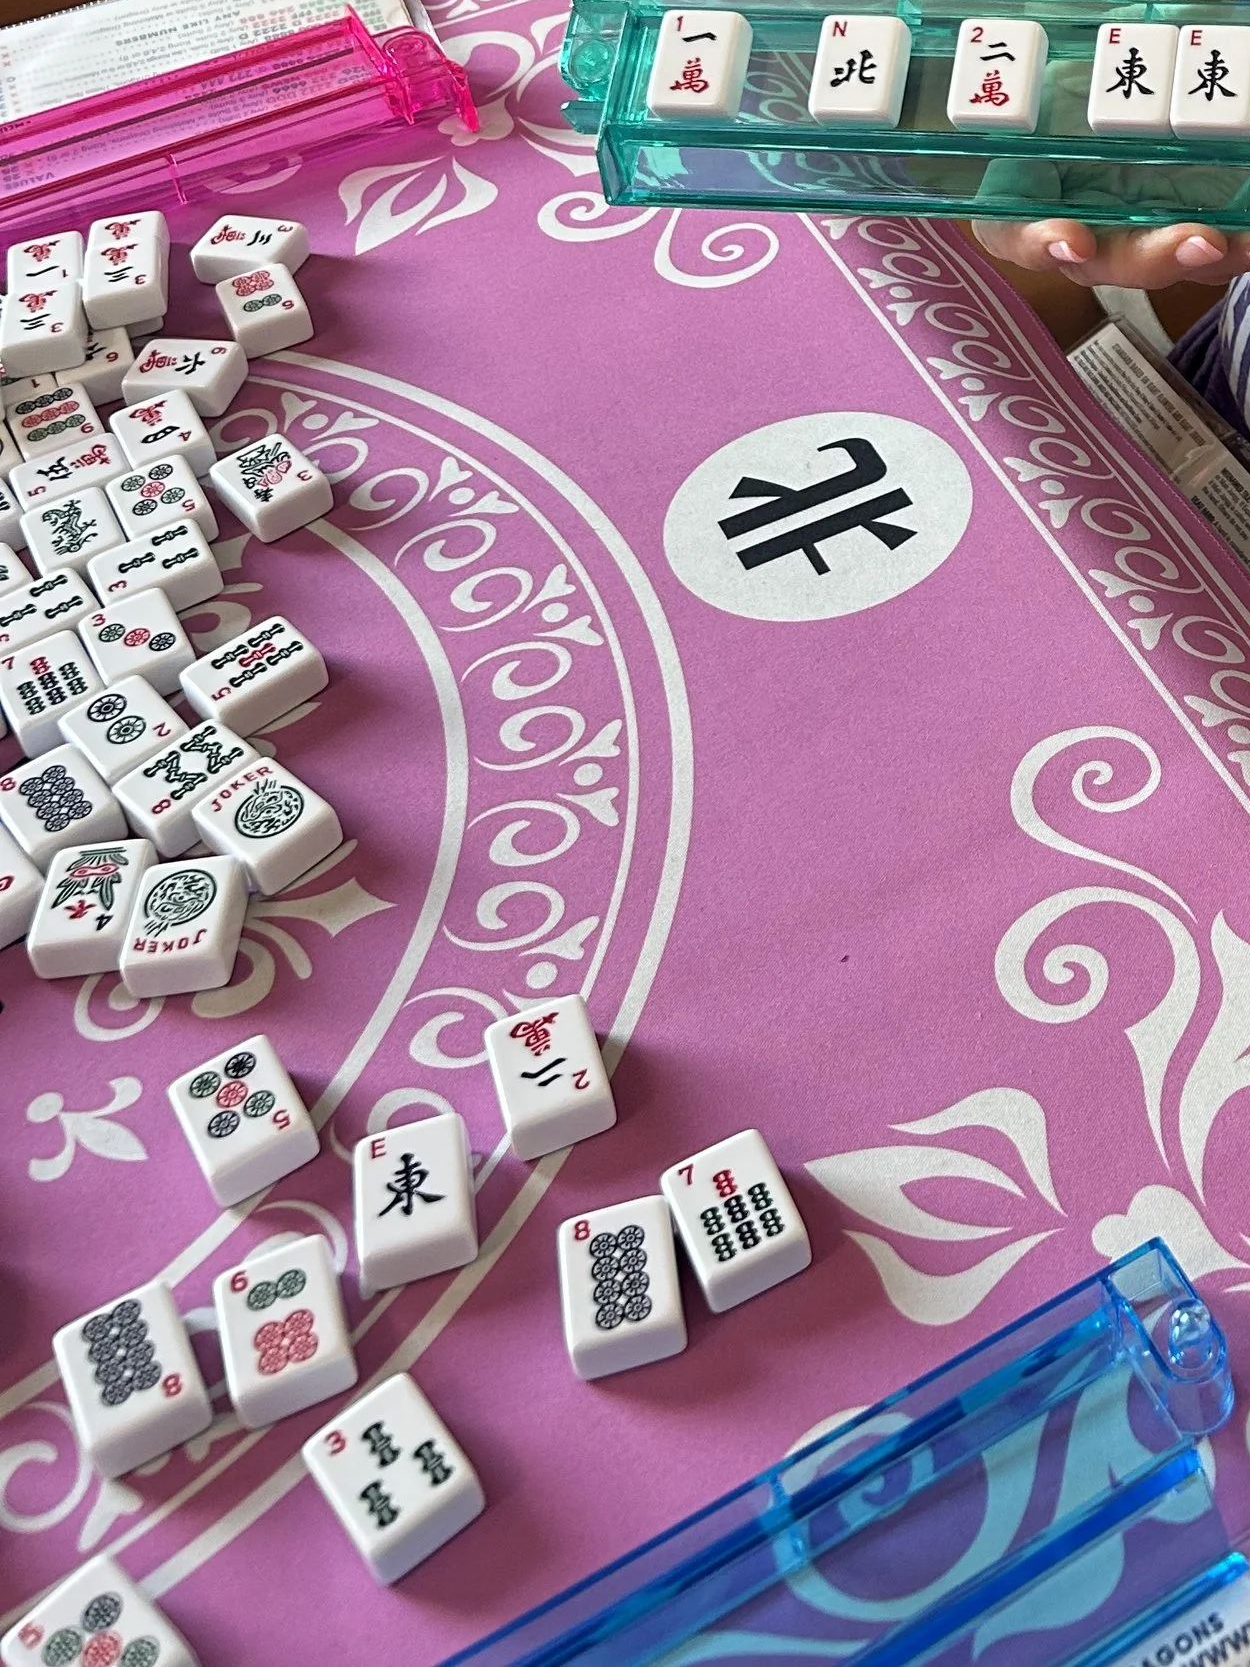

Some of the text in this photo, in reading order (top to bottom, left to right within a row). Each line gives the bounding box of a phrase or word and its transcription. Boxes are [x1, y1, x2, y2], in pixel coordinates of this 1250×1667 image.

[676, 16, 686, 32] 1
[833, 21, 849, 37] N
[970, 27, 984, 43] 2
[1109, 28, 1121, 44] E
[1190, 30, 1203, 46] E
[830, 49, 877, 88] 北
[1105, 47, 1155, 100] 東
[1187, 49, 1238, 102] 東
[717, 437, 918, 576] 北
[91, 613, 107, 628] 3
[1, 656, 16, 671] 7
[152, 722, 172, 738] 2
[211, 766, 274, 813] JOKER
[151, 798, 172, 815] 8
[95, 914, 114, 931] 4
[132, 928, 209, 954] JOKER
[572, 1069, 592, 1090] 2
[271, 1109, 292, 1130] 5
[370, 1138, 387, 1159] E
[678, 1163, 694, 1185] 7
[378, 1153, 446, 1217] 東
[574, 1219, 591, 1241] 8
[229, 1270, 249, 1293] 6
[161, 1372, 183, 1398] 8
[324, 1429, 347, 1457] 3
